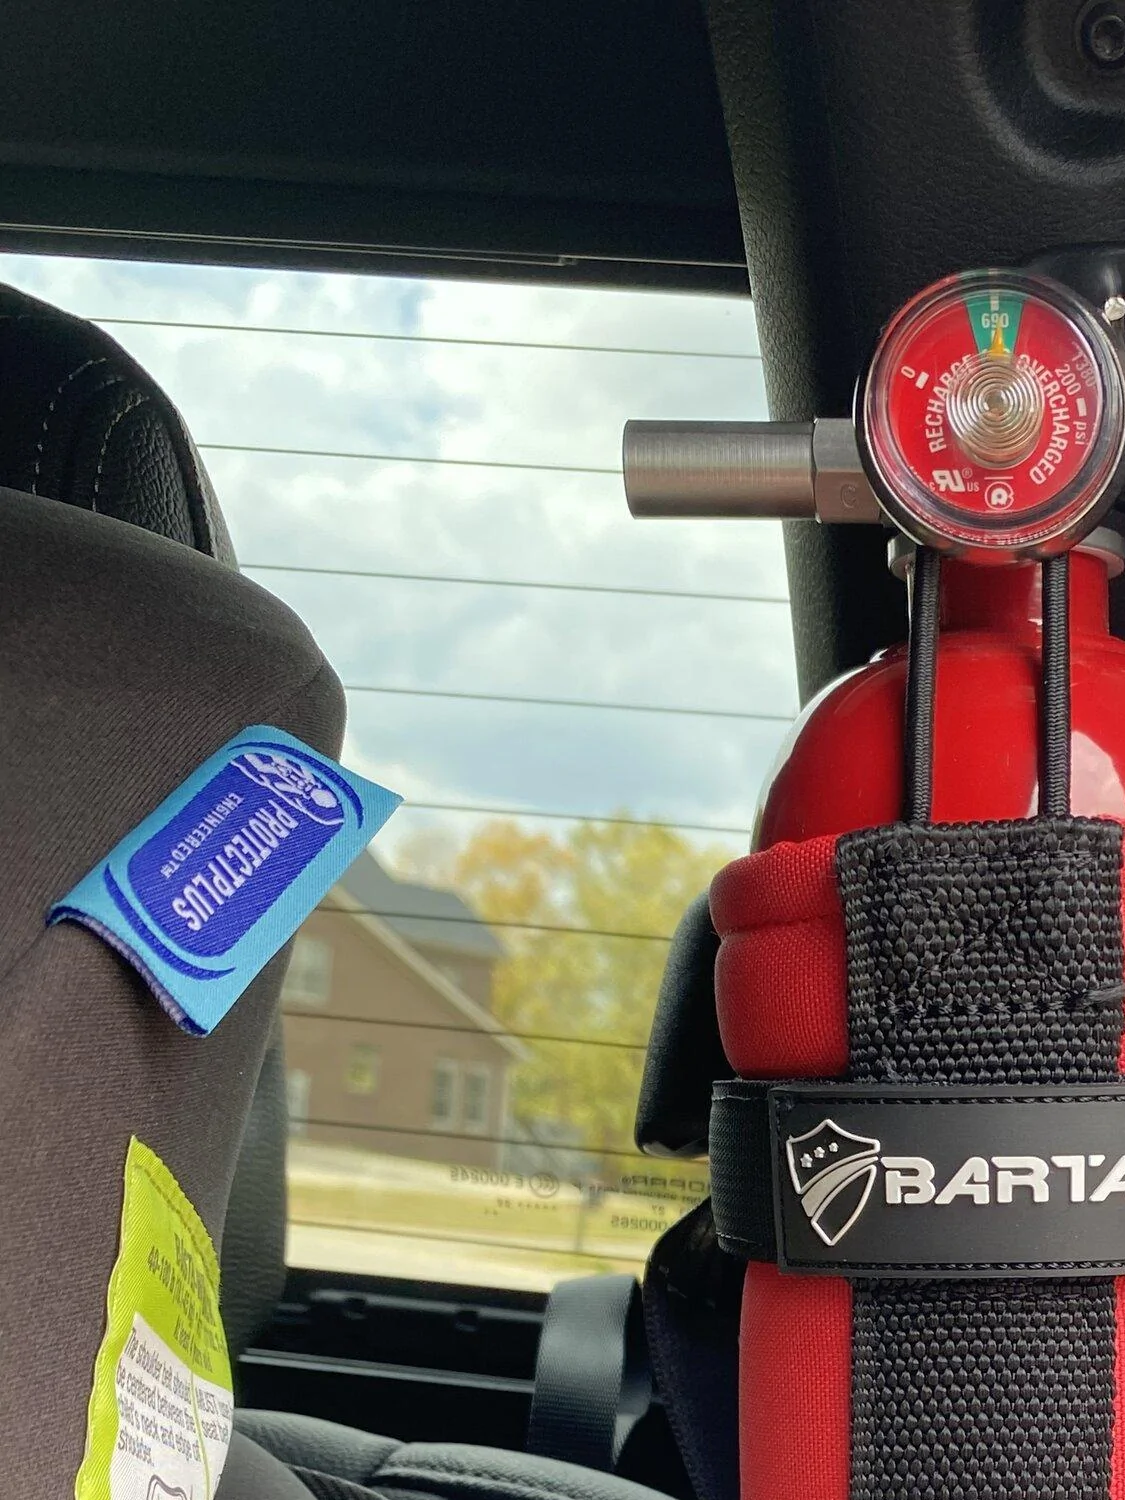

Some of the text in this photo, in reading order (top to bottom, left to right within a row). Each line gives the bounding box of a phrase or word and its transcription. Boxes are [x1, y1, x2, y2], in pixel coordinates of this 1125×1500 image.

[981, 312, 1010, 329] 690
[901, 365, 916, 379] 0
[1054, 363, 1082, 397] 200
[1015, 353, 1070, 485] OVERCHARGED
[1072, 420, 1088, 446] psi
[171, 799, 299, 931] PROTECTPLUS
